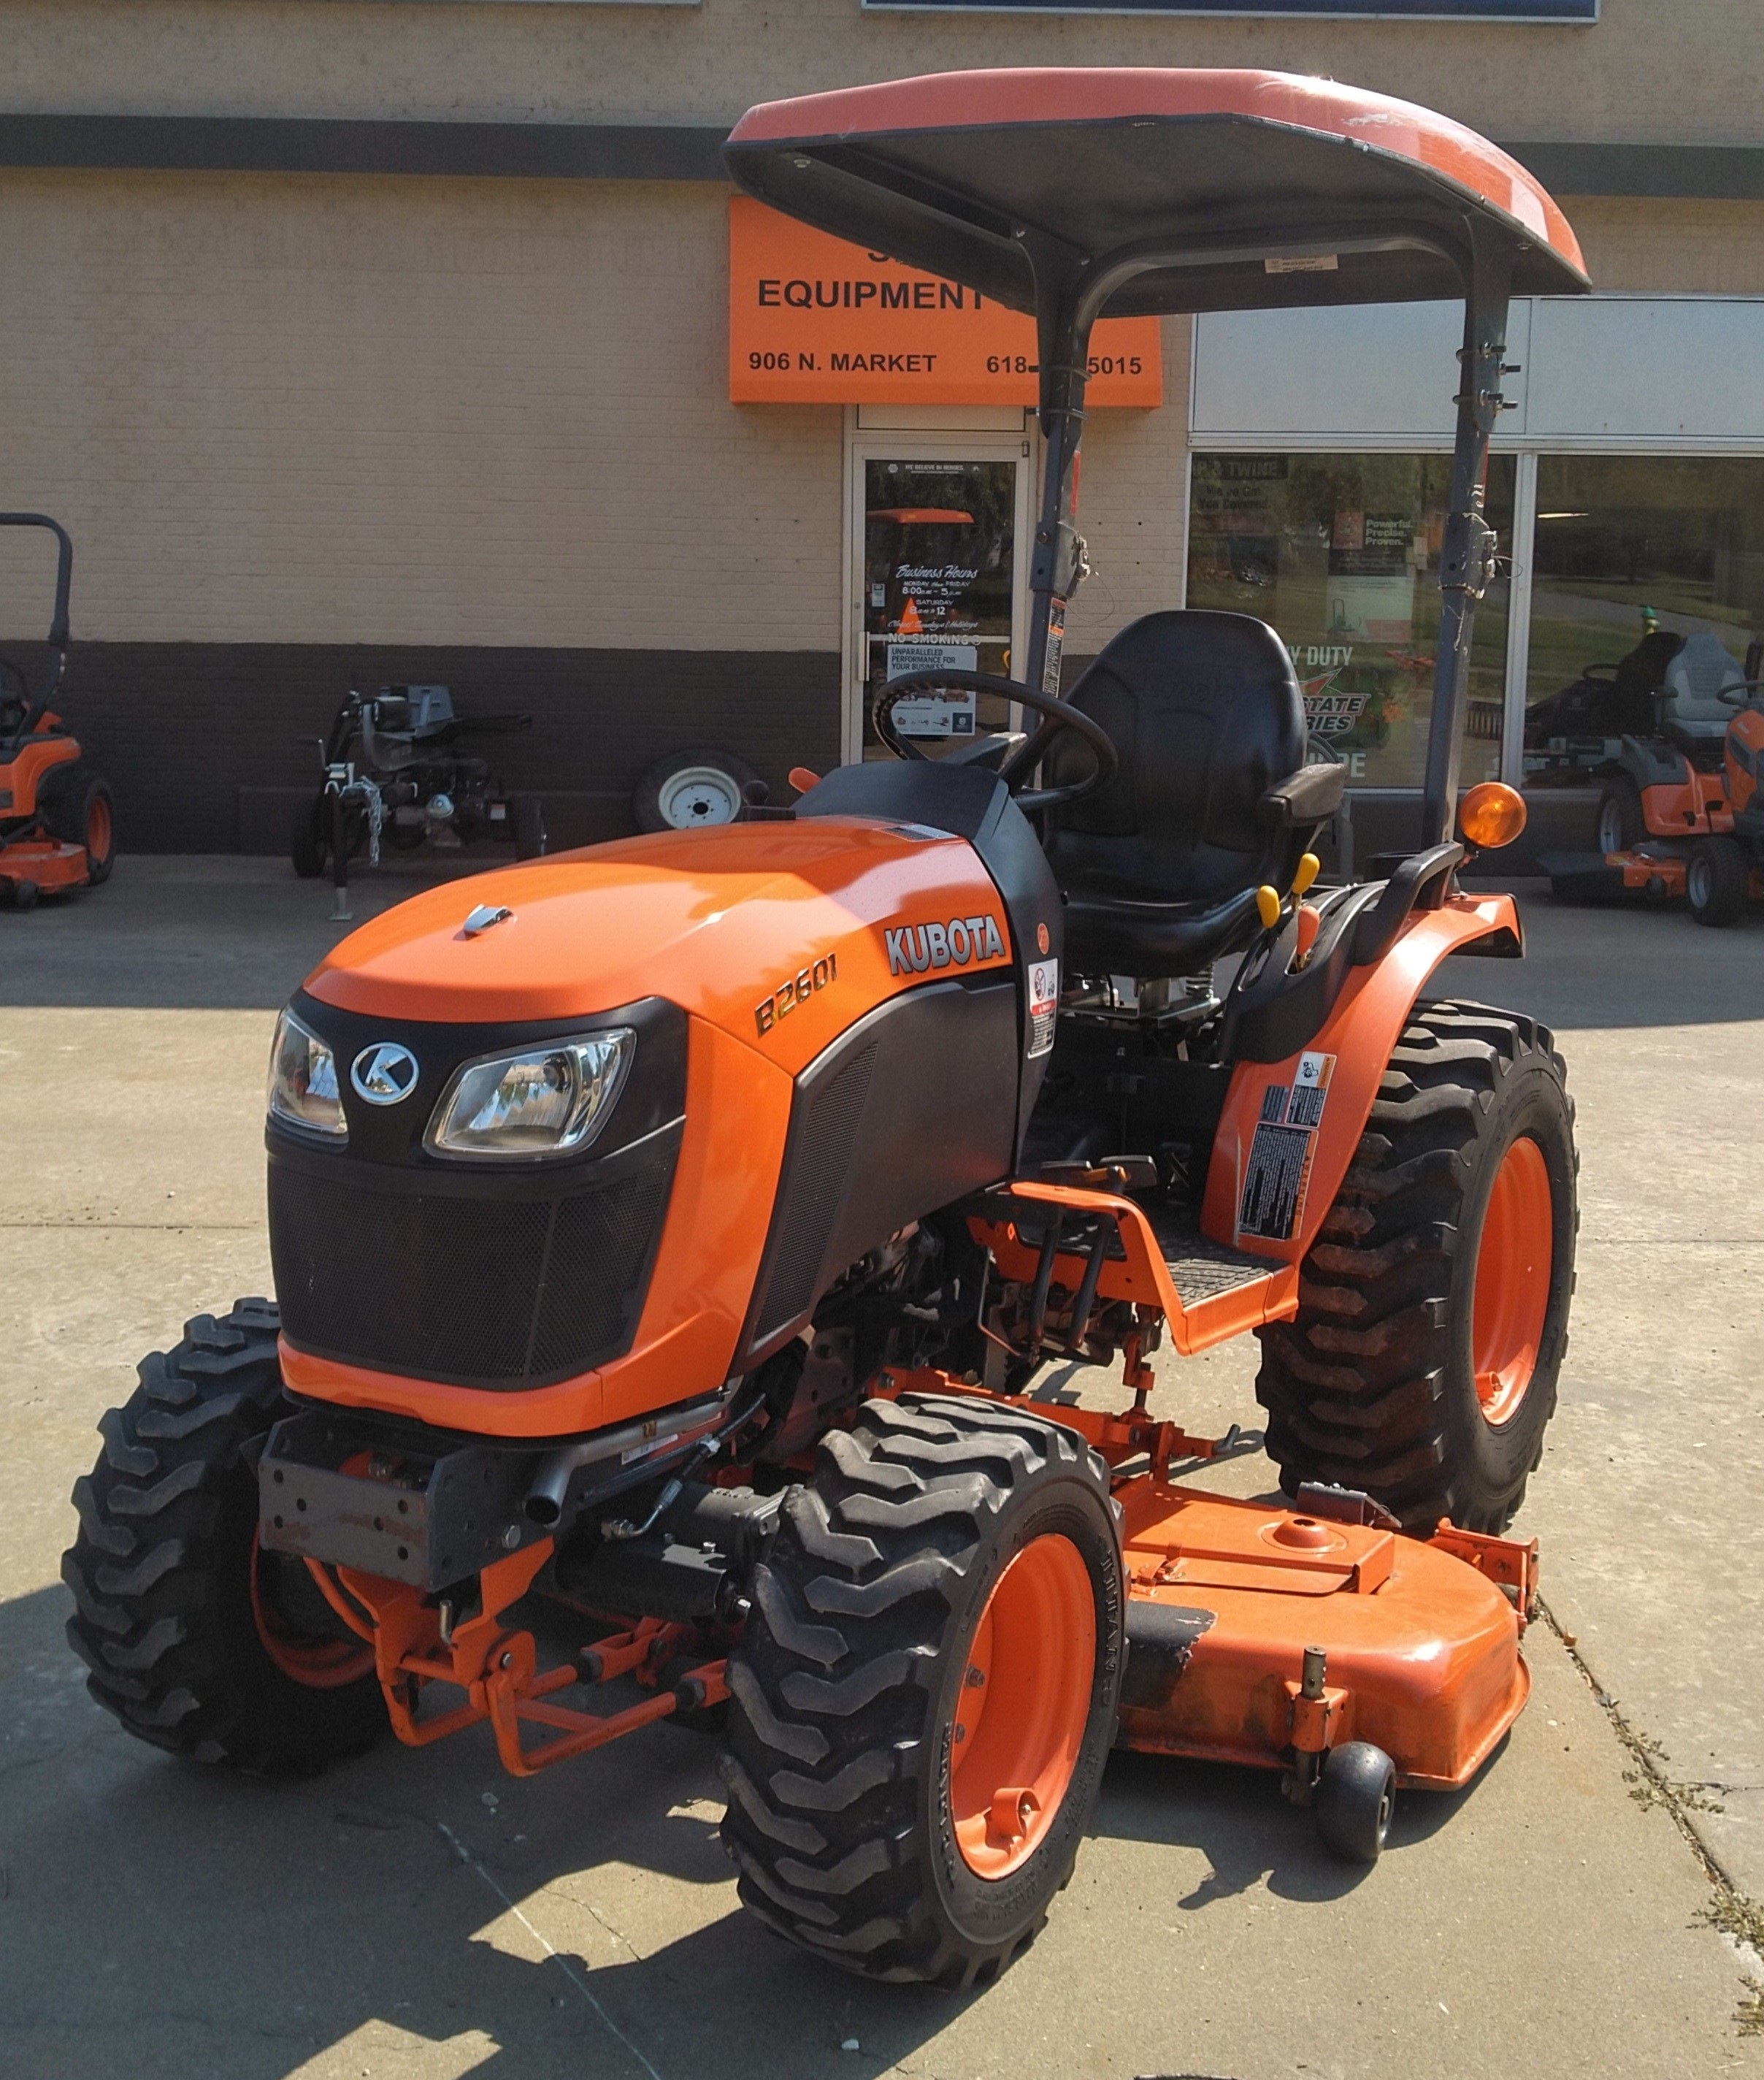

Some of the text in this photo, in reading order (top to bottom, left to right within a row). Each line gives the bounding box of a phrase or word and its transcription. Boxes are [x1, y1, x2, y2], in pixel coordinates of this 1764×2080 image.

[749, 352, 791, 370] 906
[799, 353, 822, 371] N.
[831, 353, 937, 372] MARKET
[1365, 528, 1407, 537] Precise.
[1365, 537, 1404, 546] Proven.
[895, 564, 978, 579] Business Hours
[936, 606, 946, 615] 12
[888, 632, 969, 645] NO SMOKING
[1307, 646, 1353, 665] DUTY
[1306, 716, 1351, 730] RIES
[884, 916, 1005, 975] KUBOTA
[754, 952, 838, 1039] B2601
